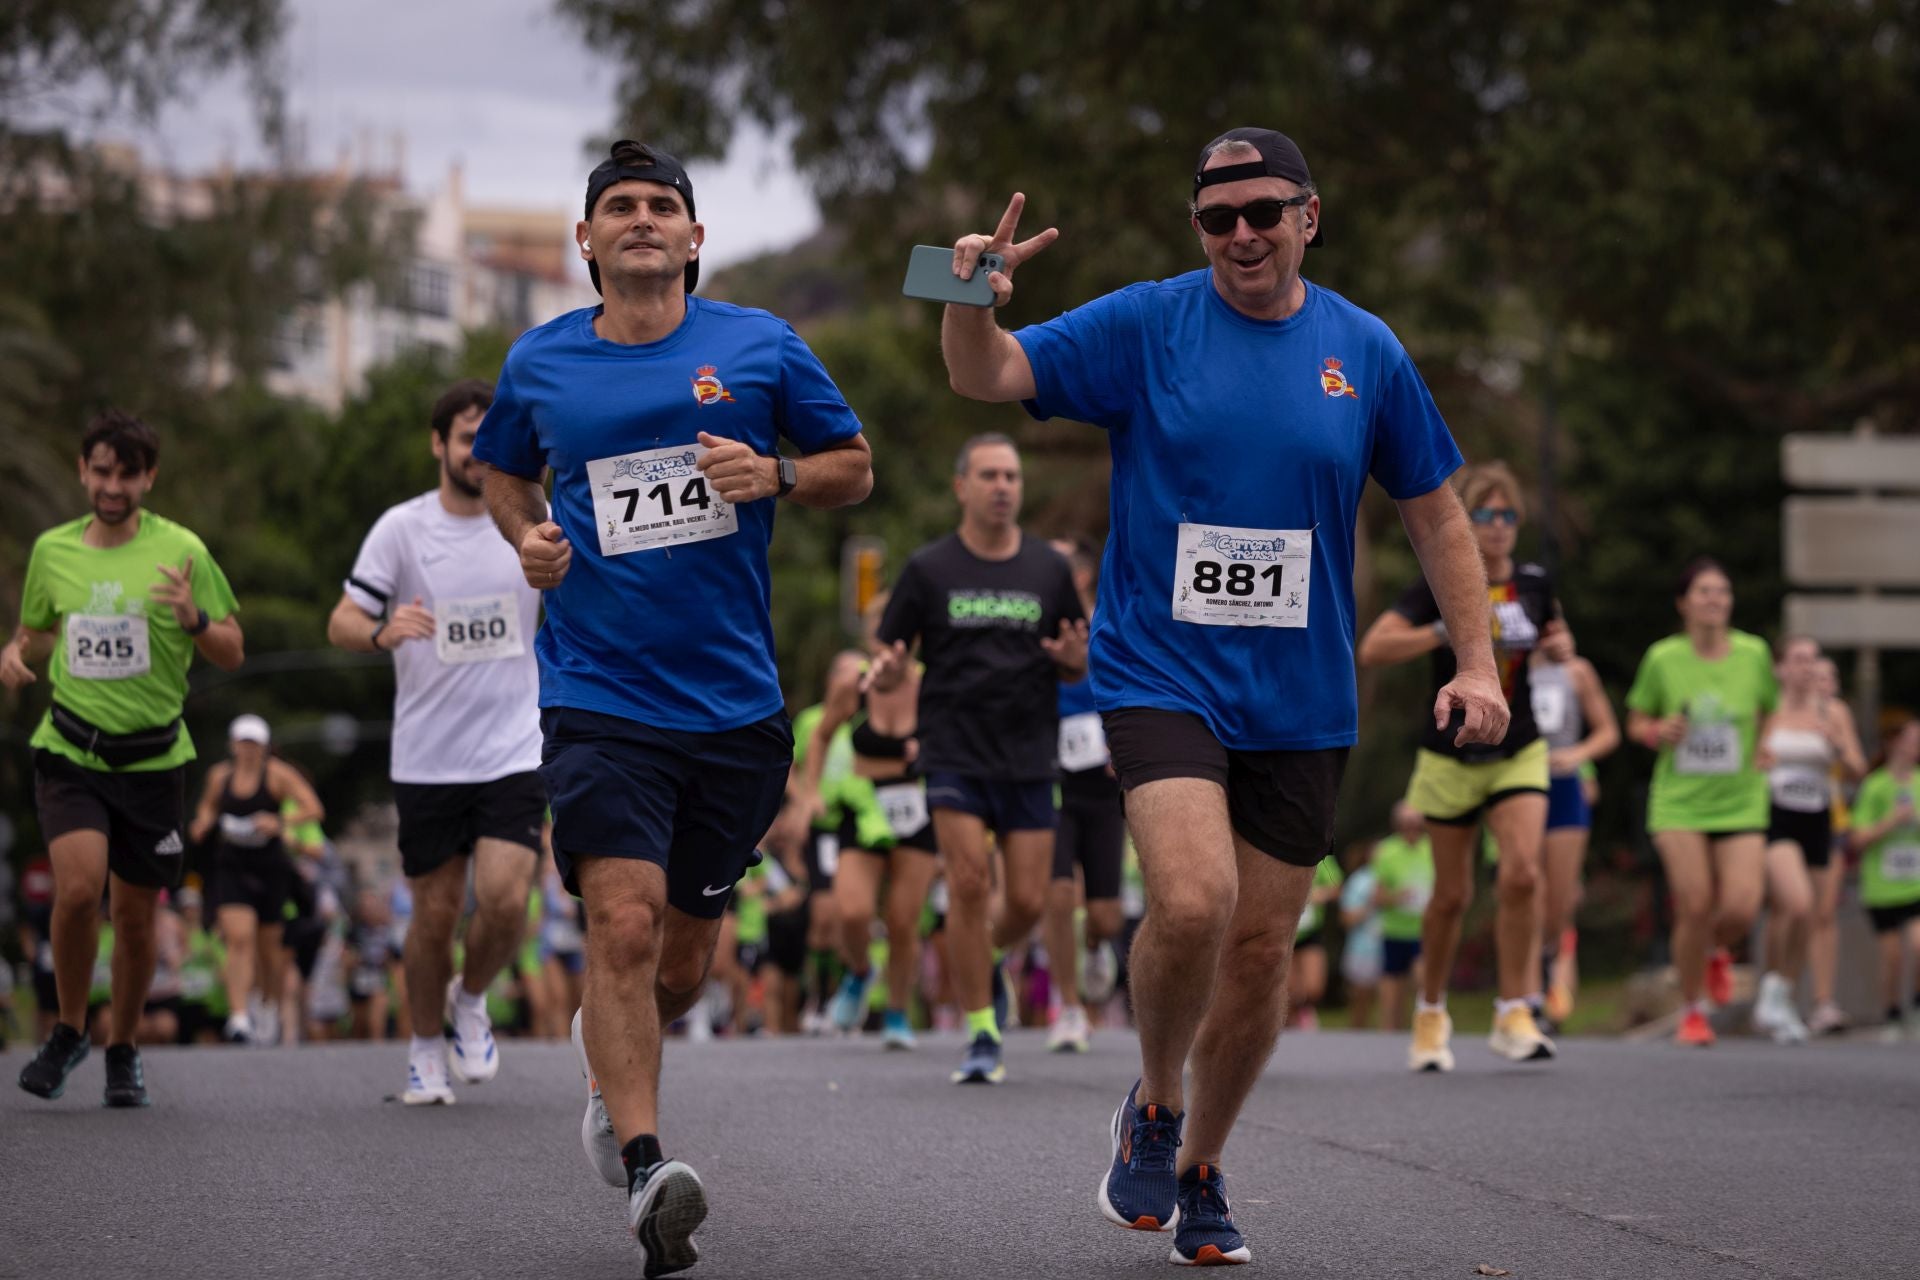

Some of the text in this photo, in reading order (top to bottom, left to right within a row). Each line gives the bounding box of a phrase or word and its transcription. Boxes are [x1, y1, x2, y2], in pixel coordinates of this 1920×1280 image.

[631, 456, 686, 474] Carrera
[613, 477, 711, 522] 714
[629, 524, 650, 533] OLMEDO
[687, 514, 706, 523] VICENTE
[1218, 536, 1273, 551] Carrera
[1229, 549, 1277, 560] Prensa
[1193, 560, 1283, 597] 881
[948, 596, 1042, 623] CHICAGO
[1206, 598, 1228, 607] ROMERO
[1254, 600, 1274, 608] ANTONIO
[448, 616, 506, 644] 860
[78, 637, 133, 659] 245
